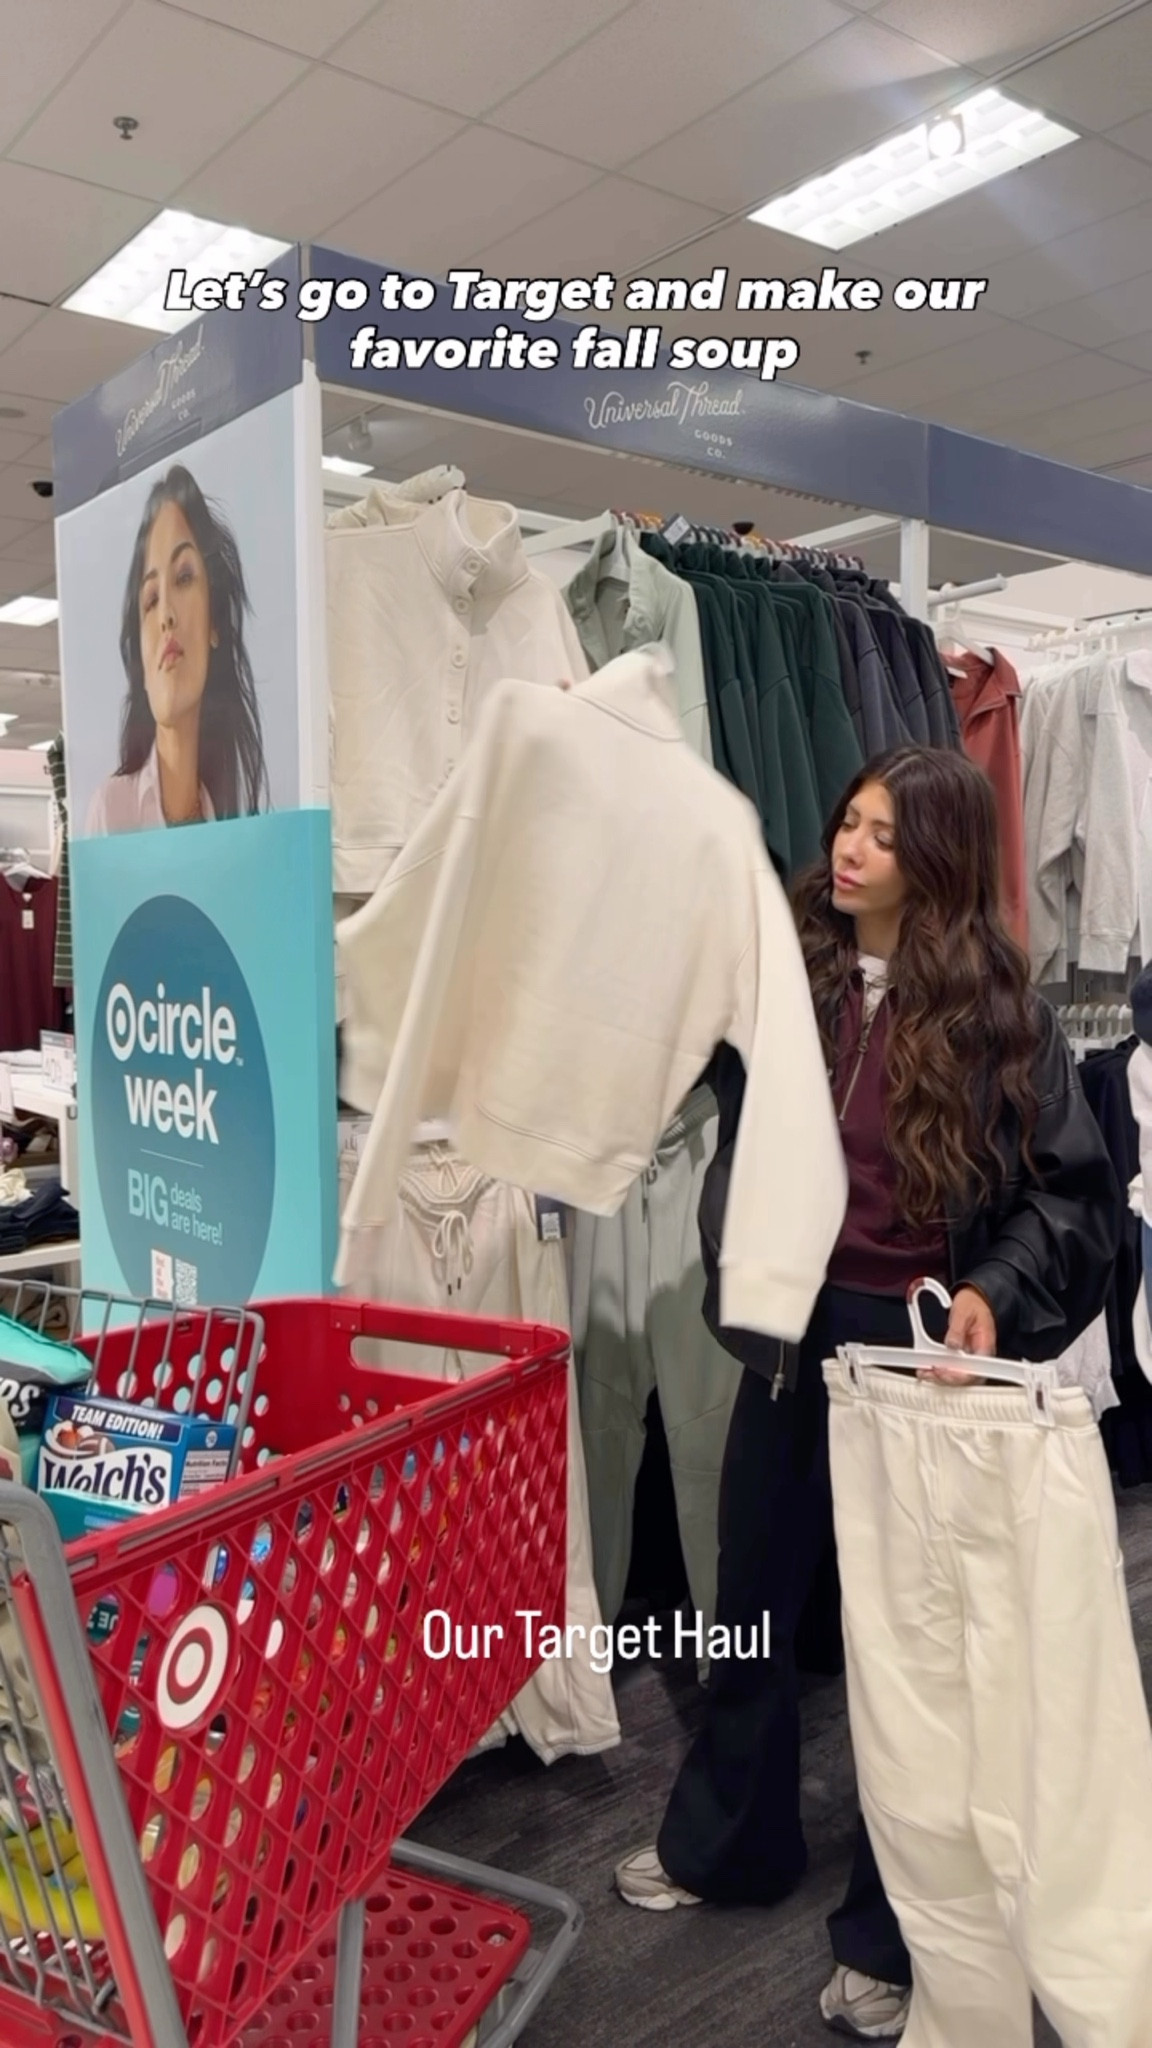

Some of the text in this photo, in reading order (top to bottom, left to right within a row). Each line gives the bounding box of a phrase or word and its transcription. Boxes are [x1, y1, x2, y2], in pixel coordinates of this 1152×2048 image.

[584, 388, 680, 429] Universal
[694, 428, 734, 447] GOODS
[137, 982, 237, 1064] circle
[123, 1068, 220, 1145] week
[127, 1168, 169, 1227] BIG
[170, 1182, 202, 1213] deals
[171, 1211, 223, 1246] are here!
[0, 1376, 40, 1418] PS
[71, 1404, 165, 1441] TEAM EDITION!
[43, 1453, 167, 1505] Welch's
